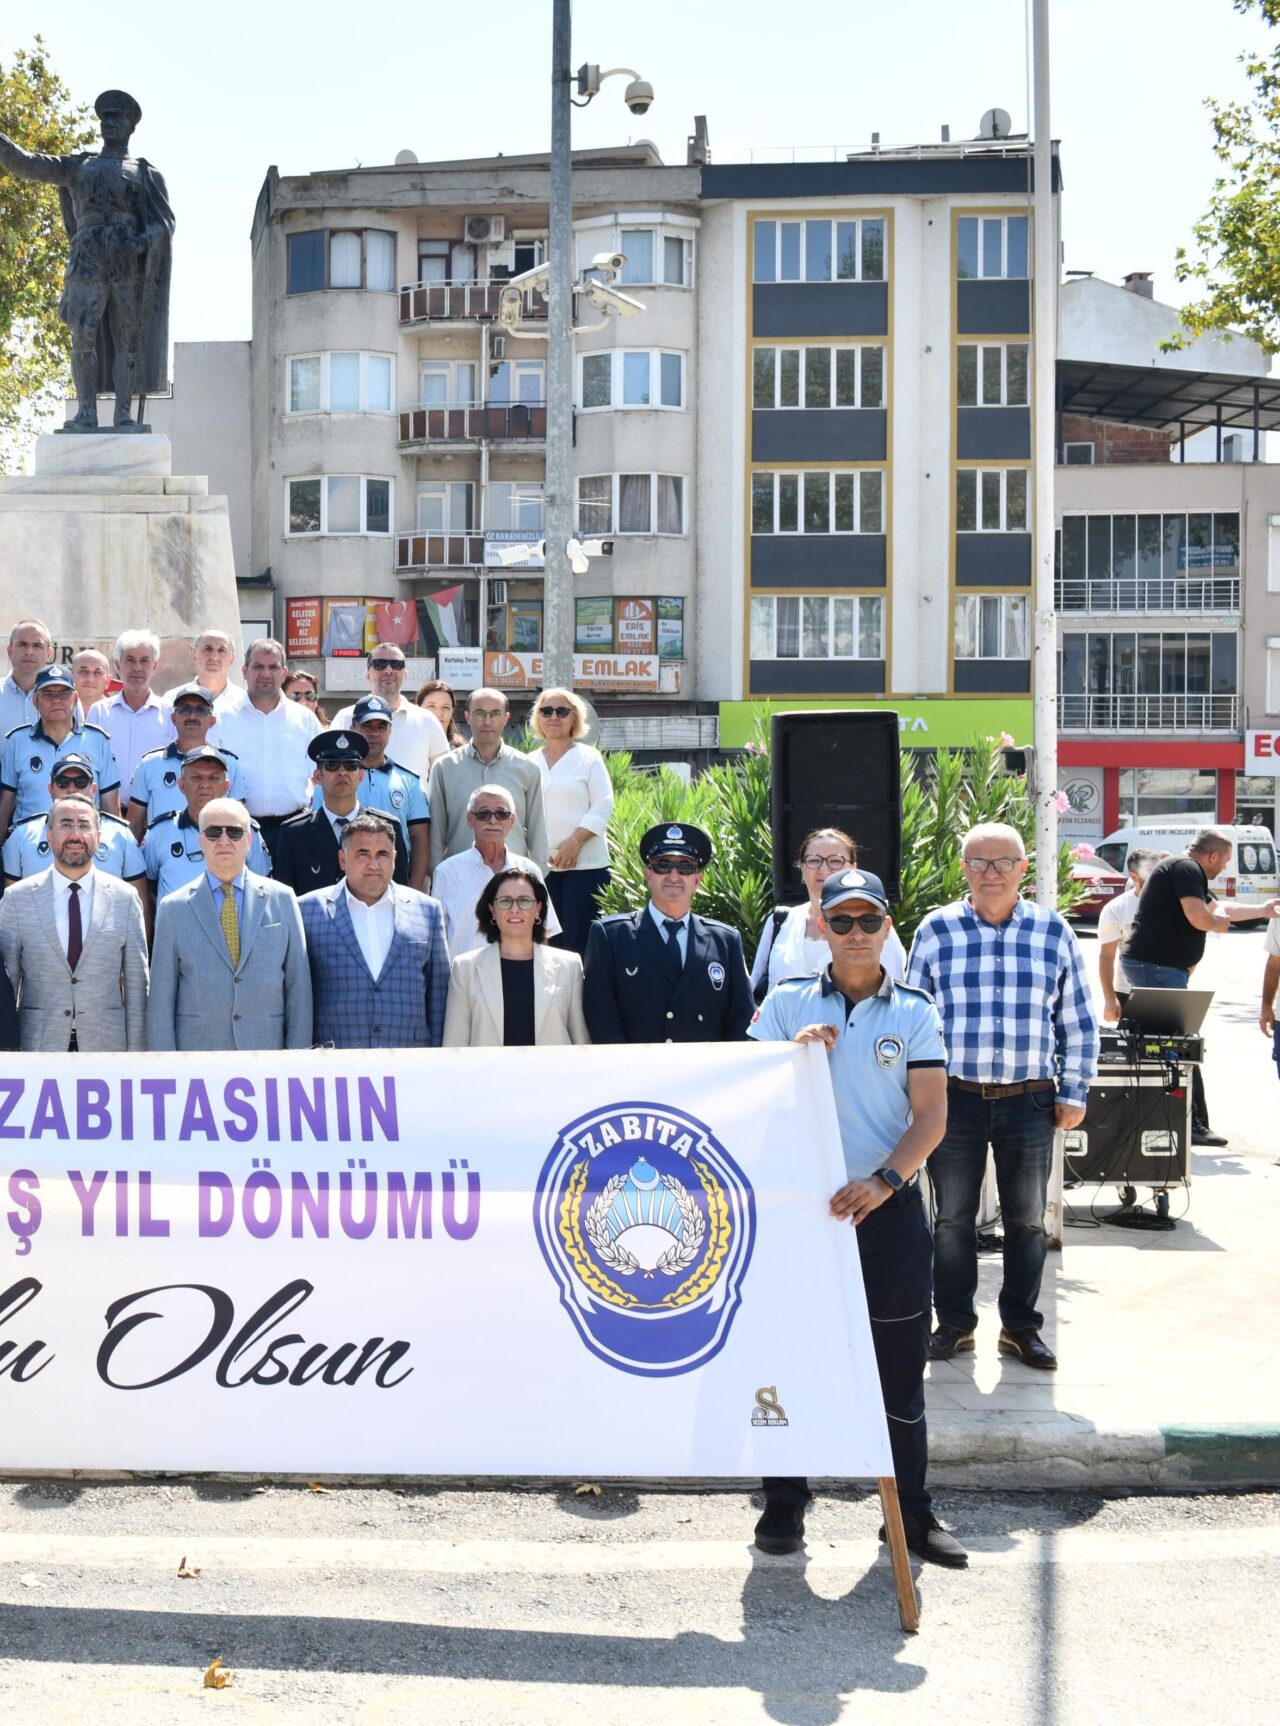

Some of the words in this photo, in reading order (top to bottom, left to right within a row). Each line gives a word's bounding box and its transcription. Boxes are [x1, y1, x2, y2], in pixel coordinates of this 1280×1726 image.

[291, 609, 316, 618] GELECEK
[582, 660, 652, 676] EMLAK
[578, 1115, 695, 1158] ZABITA
[68, 1170, 171, 1237] YIL
[198, 1158, 481, 1241] DÖNÜMÜ
[96, 1278, 414, 1391] Olsun
